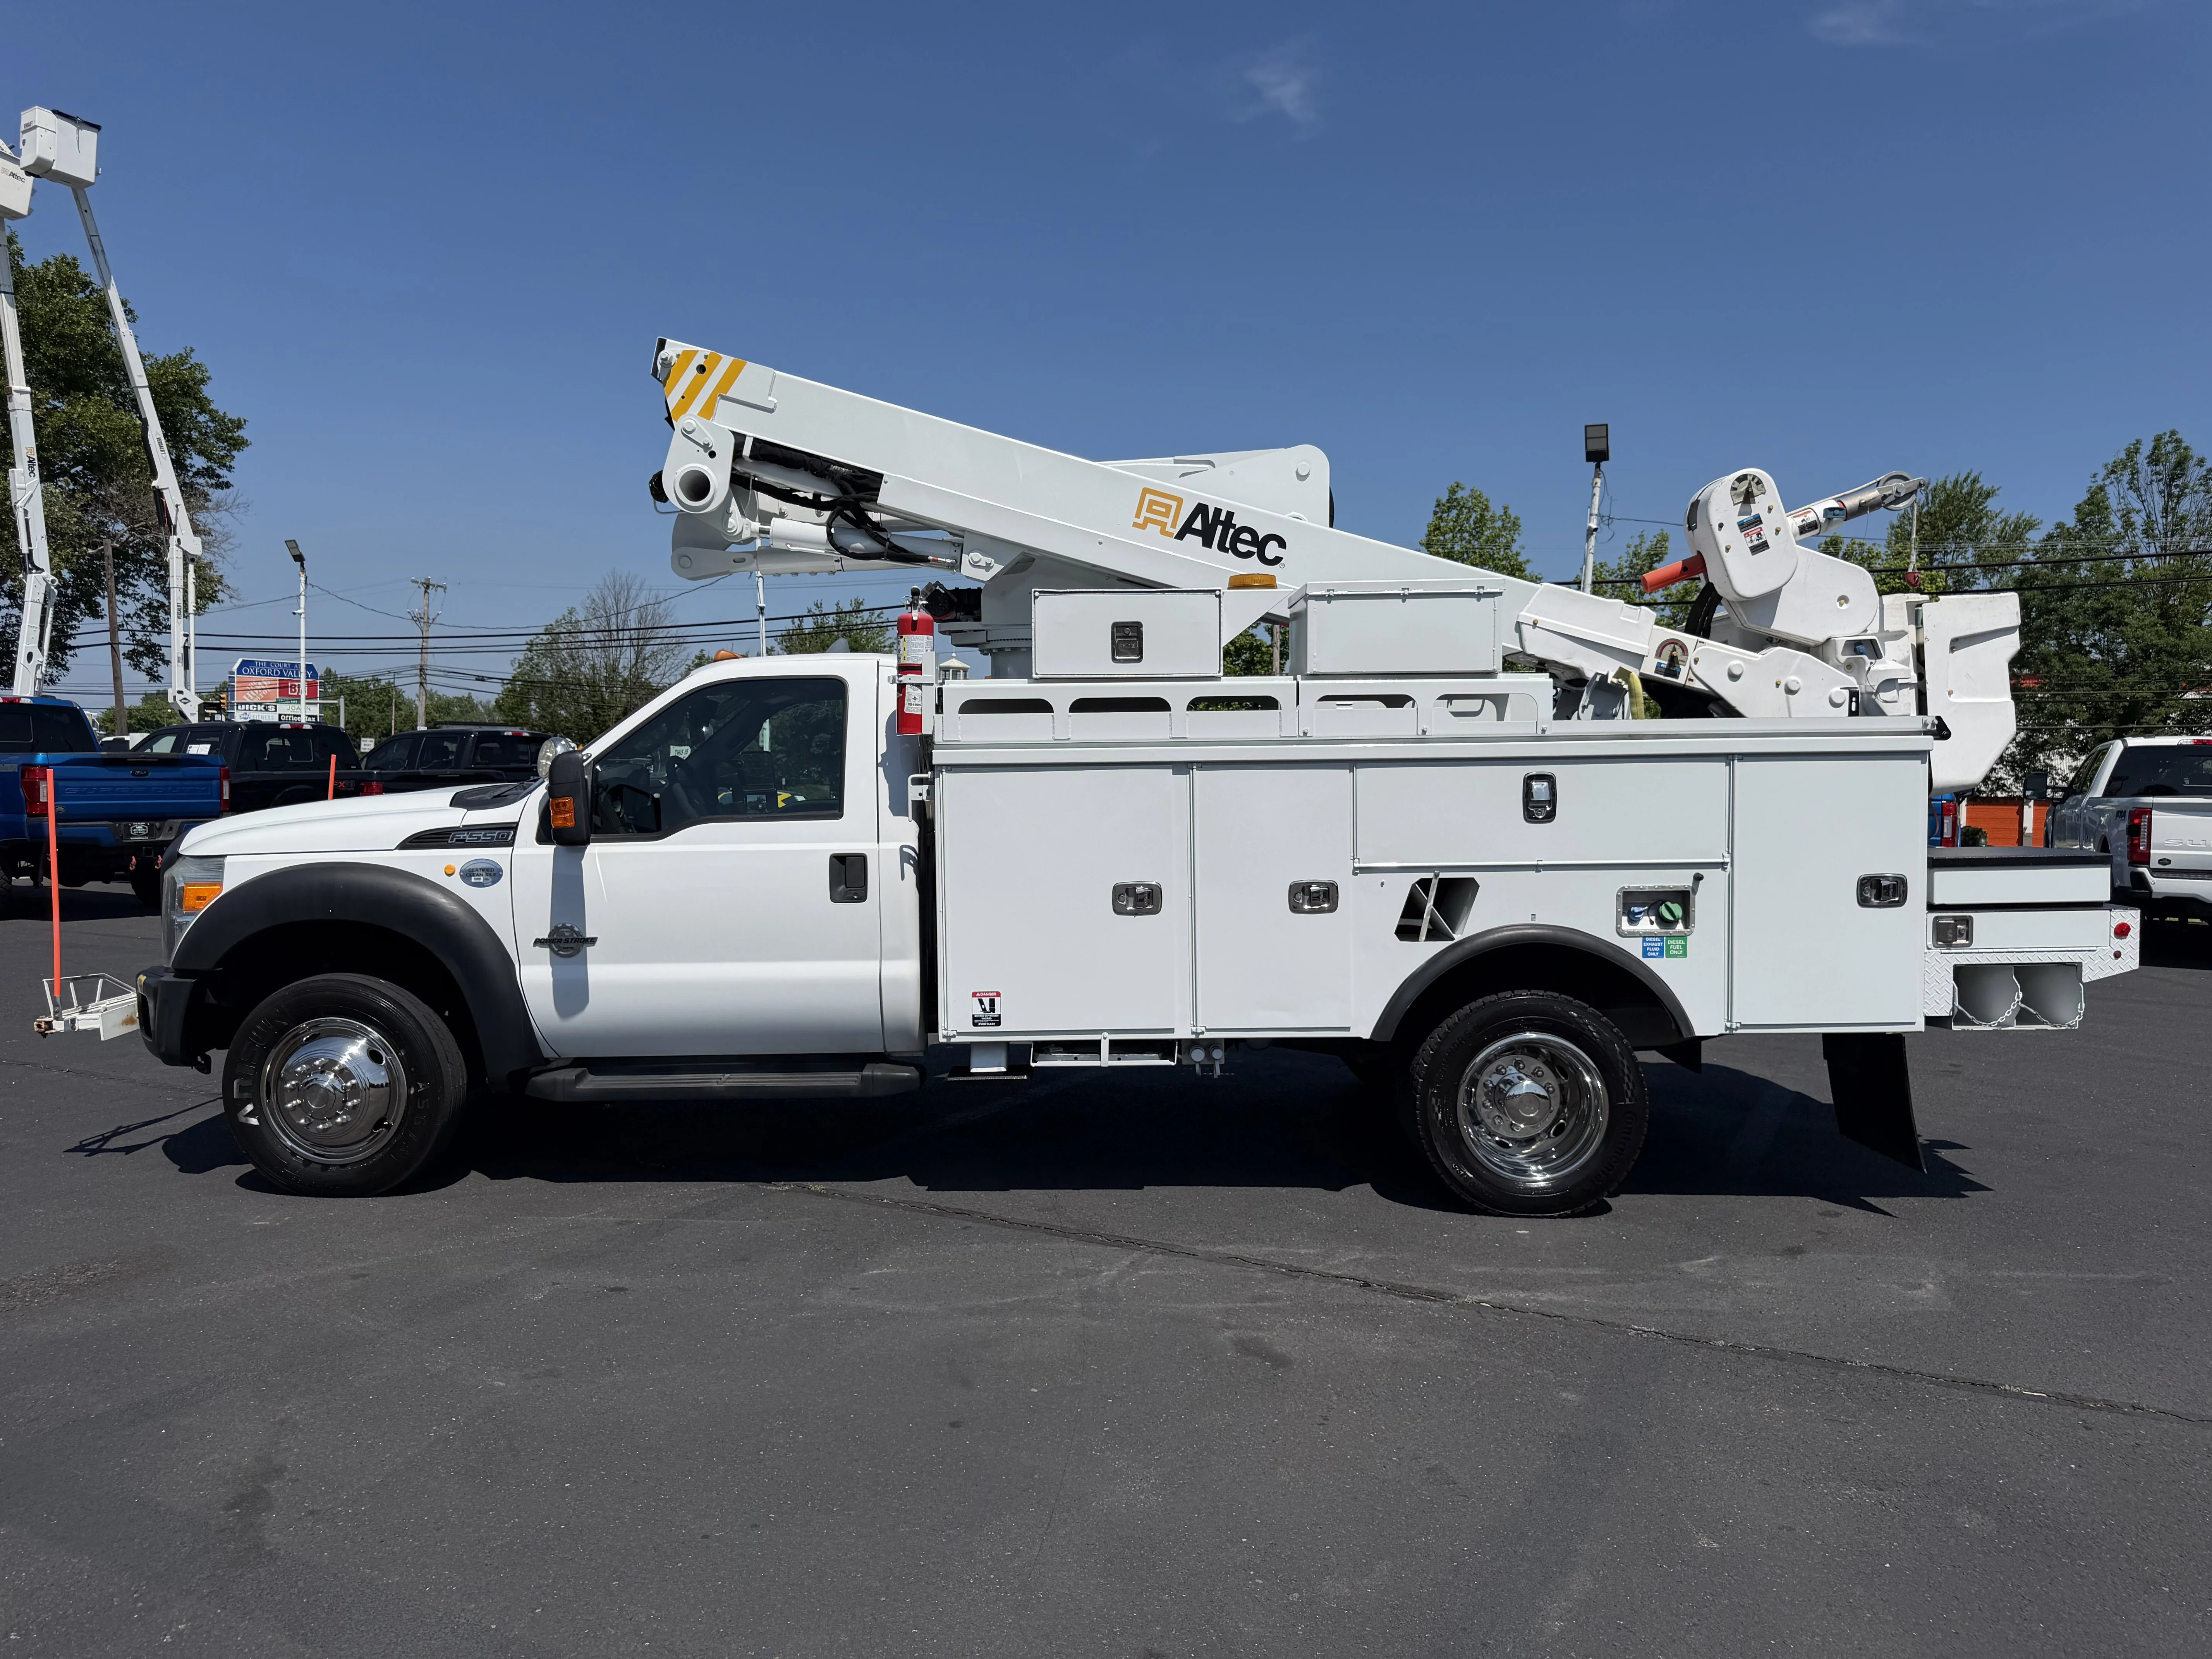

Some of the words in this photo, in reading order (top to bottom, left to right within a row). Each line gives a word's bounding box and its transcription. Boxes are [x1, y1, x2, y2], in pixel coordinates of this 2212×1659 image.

[9, 172, 26, 183] Altec
[26, 455, 36, 477] Altec
[1174, 502, 1287, 566] Altec
[242, 667, 280, 676] OXFORD
